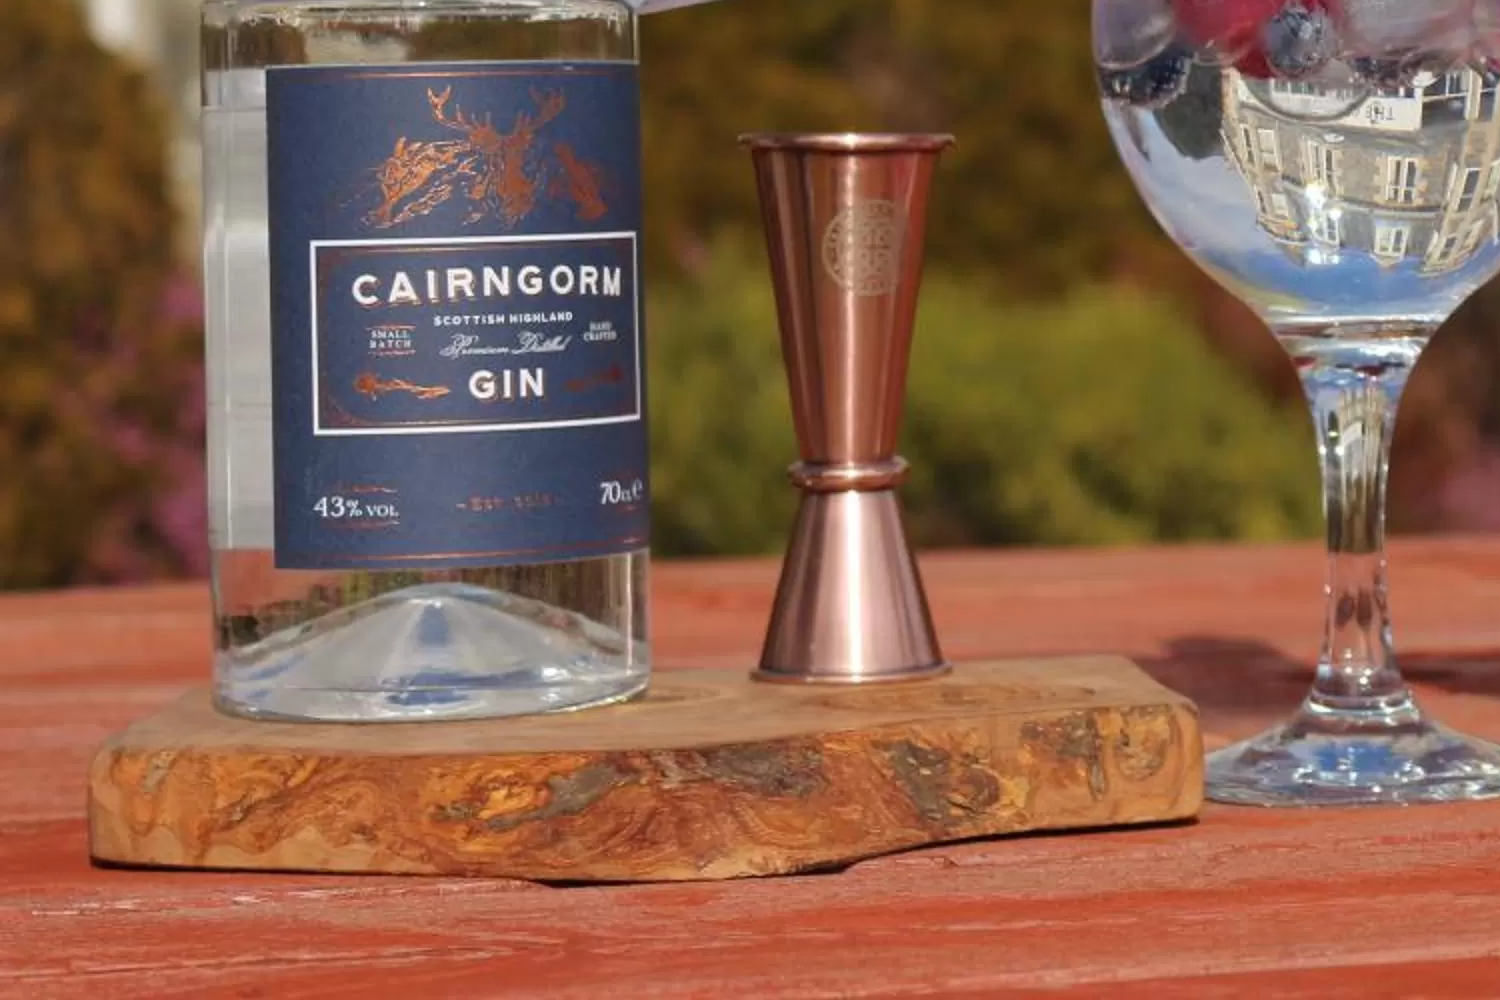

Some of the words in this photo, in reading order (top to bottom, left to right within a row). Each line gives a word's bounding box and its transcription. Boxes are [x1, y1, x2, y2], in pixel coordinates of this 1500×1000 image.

[352, 264, 621, 305] CAIRNGORM
[433, 314, 505, 327] SCOTTISH
[509, 311, 573, 324] HIGHLAND
[469, 368, 544, 400] GIN
[313, 495, 363, 518] 43%
